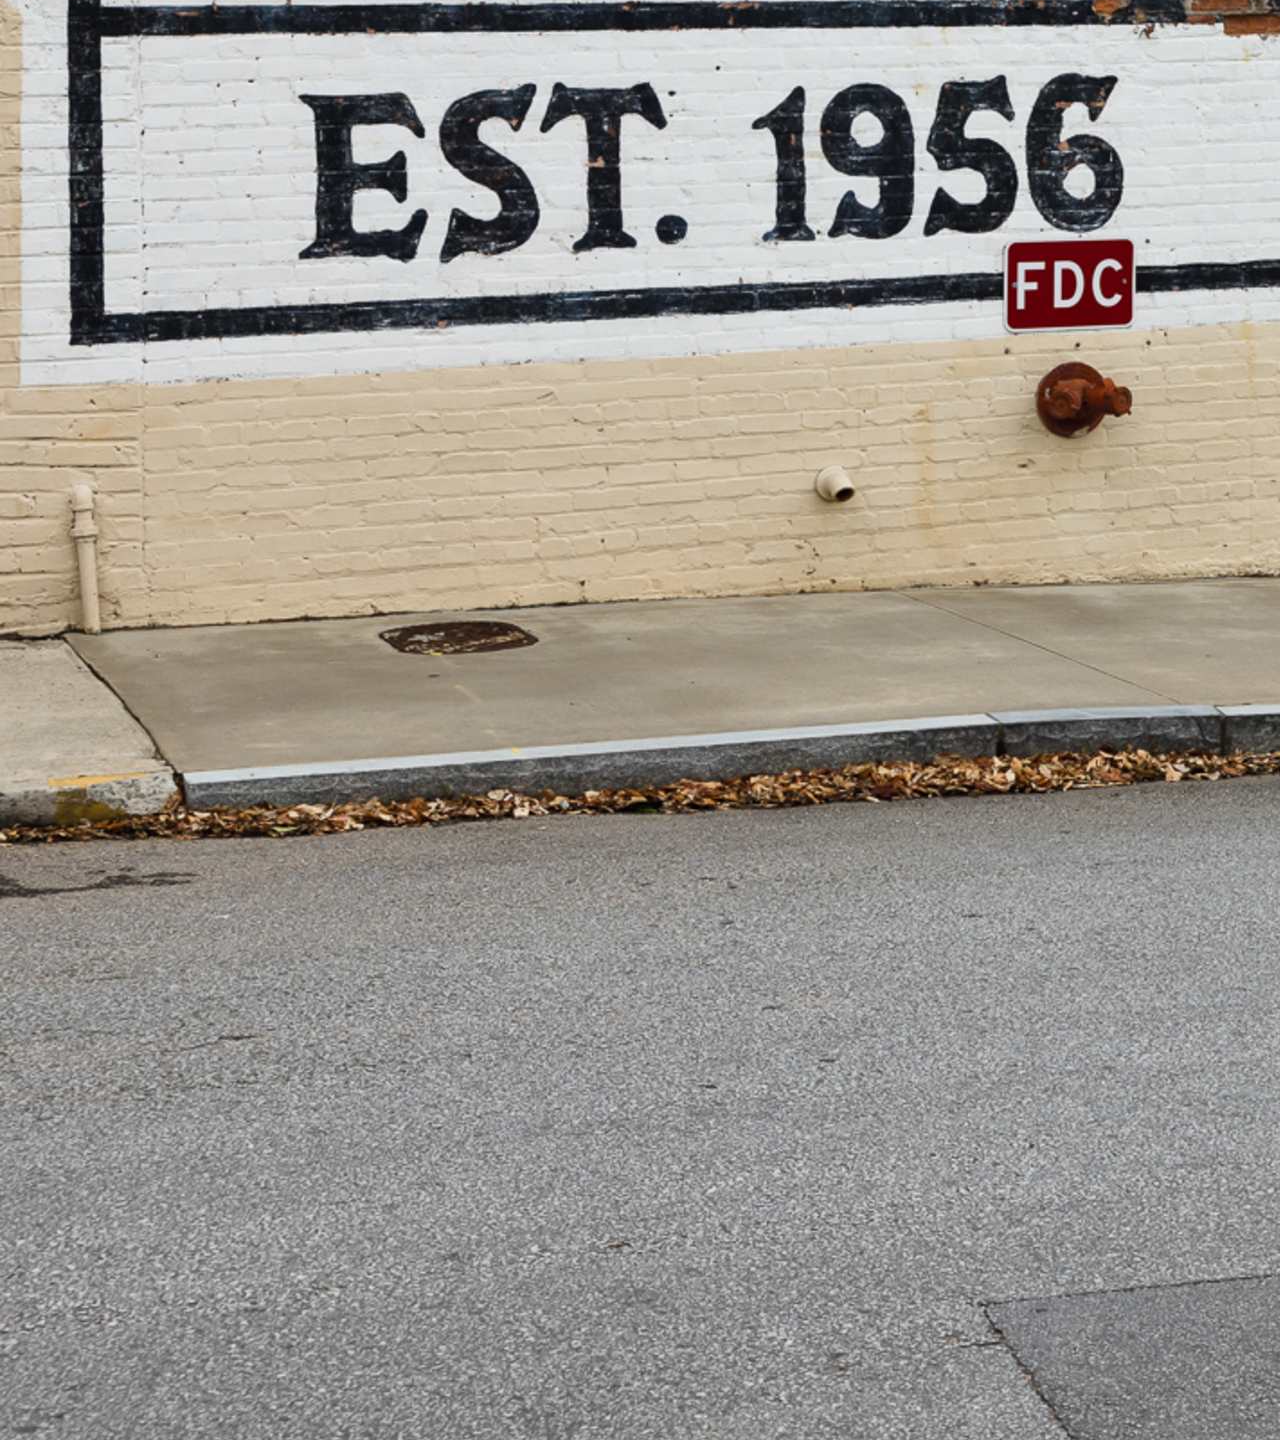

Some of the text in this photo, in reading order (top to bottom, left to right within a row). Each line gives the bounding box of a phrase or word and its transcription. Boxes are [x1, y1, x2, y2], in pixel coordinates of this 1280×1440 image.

[298, 72, 1124, 264] EST. 1956
[1014, 258, 1124, 312] FDC
